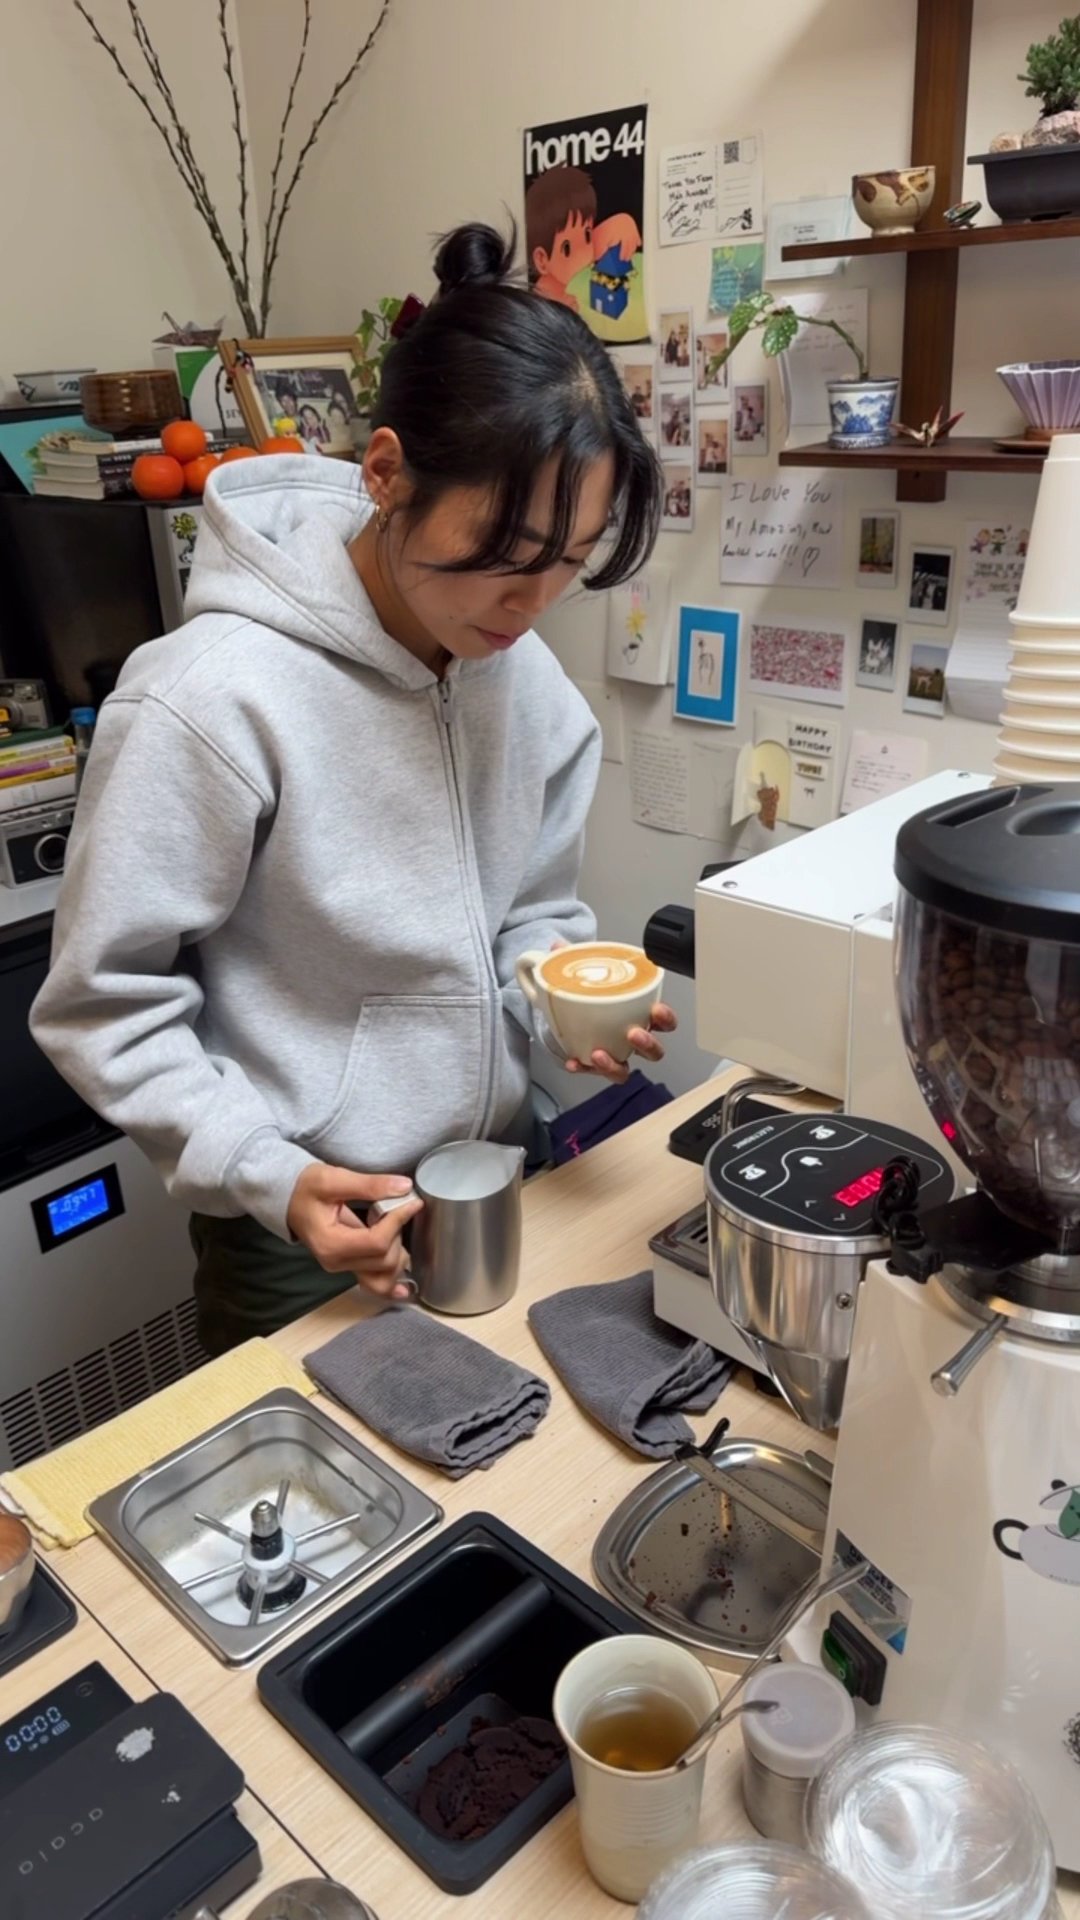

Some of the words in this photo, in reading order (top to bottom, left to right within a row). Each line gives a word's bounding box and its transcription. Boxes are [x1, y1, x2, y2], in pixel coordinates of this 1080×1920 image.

[525, 127, 610, 175] home
[613, 119, 645, 158] 44
[730, 482, 746, 501] I
[750, 483, 790, 503] Love
[804, 481, 832, 503] You
[795, 724, 828, 737] HAPPY
[788, 737, 832, 753] BIRTHDAY
[5, 1706, 62, 1752] 00:00
